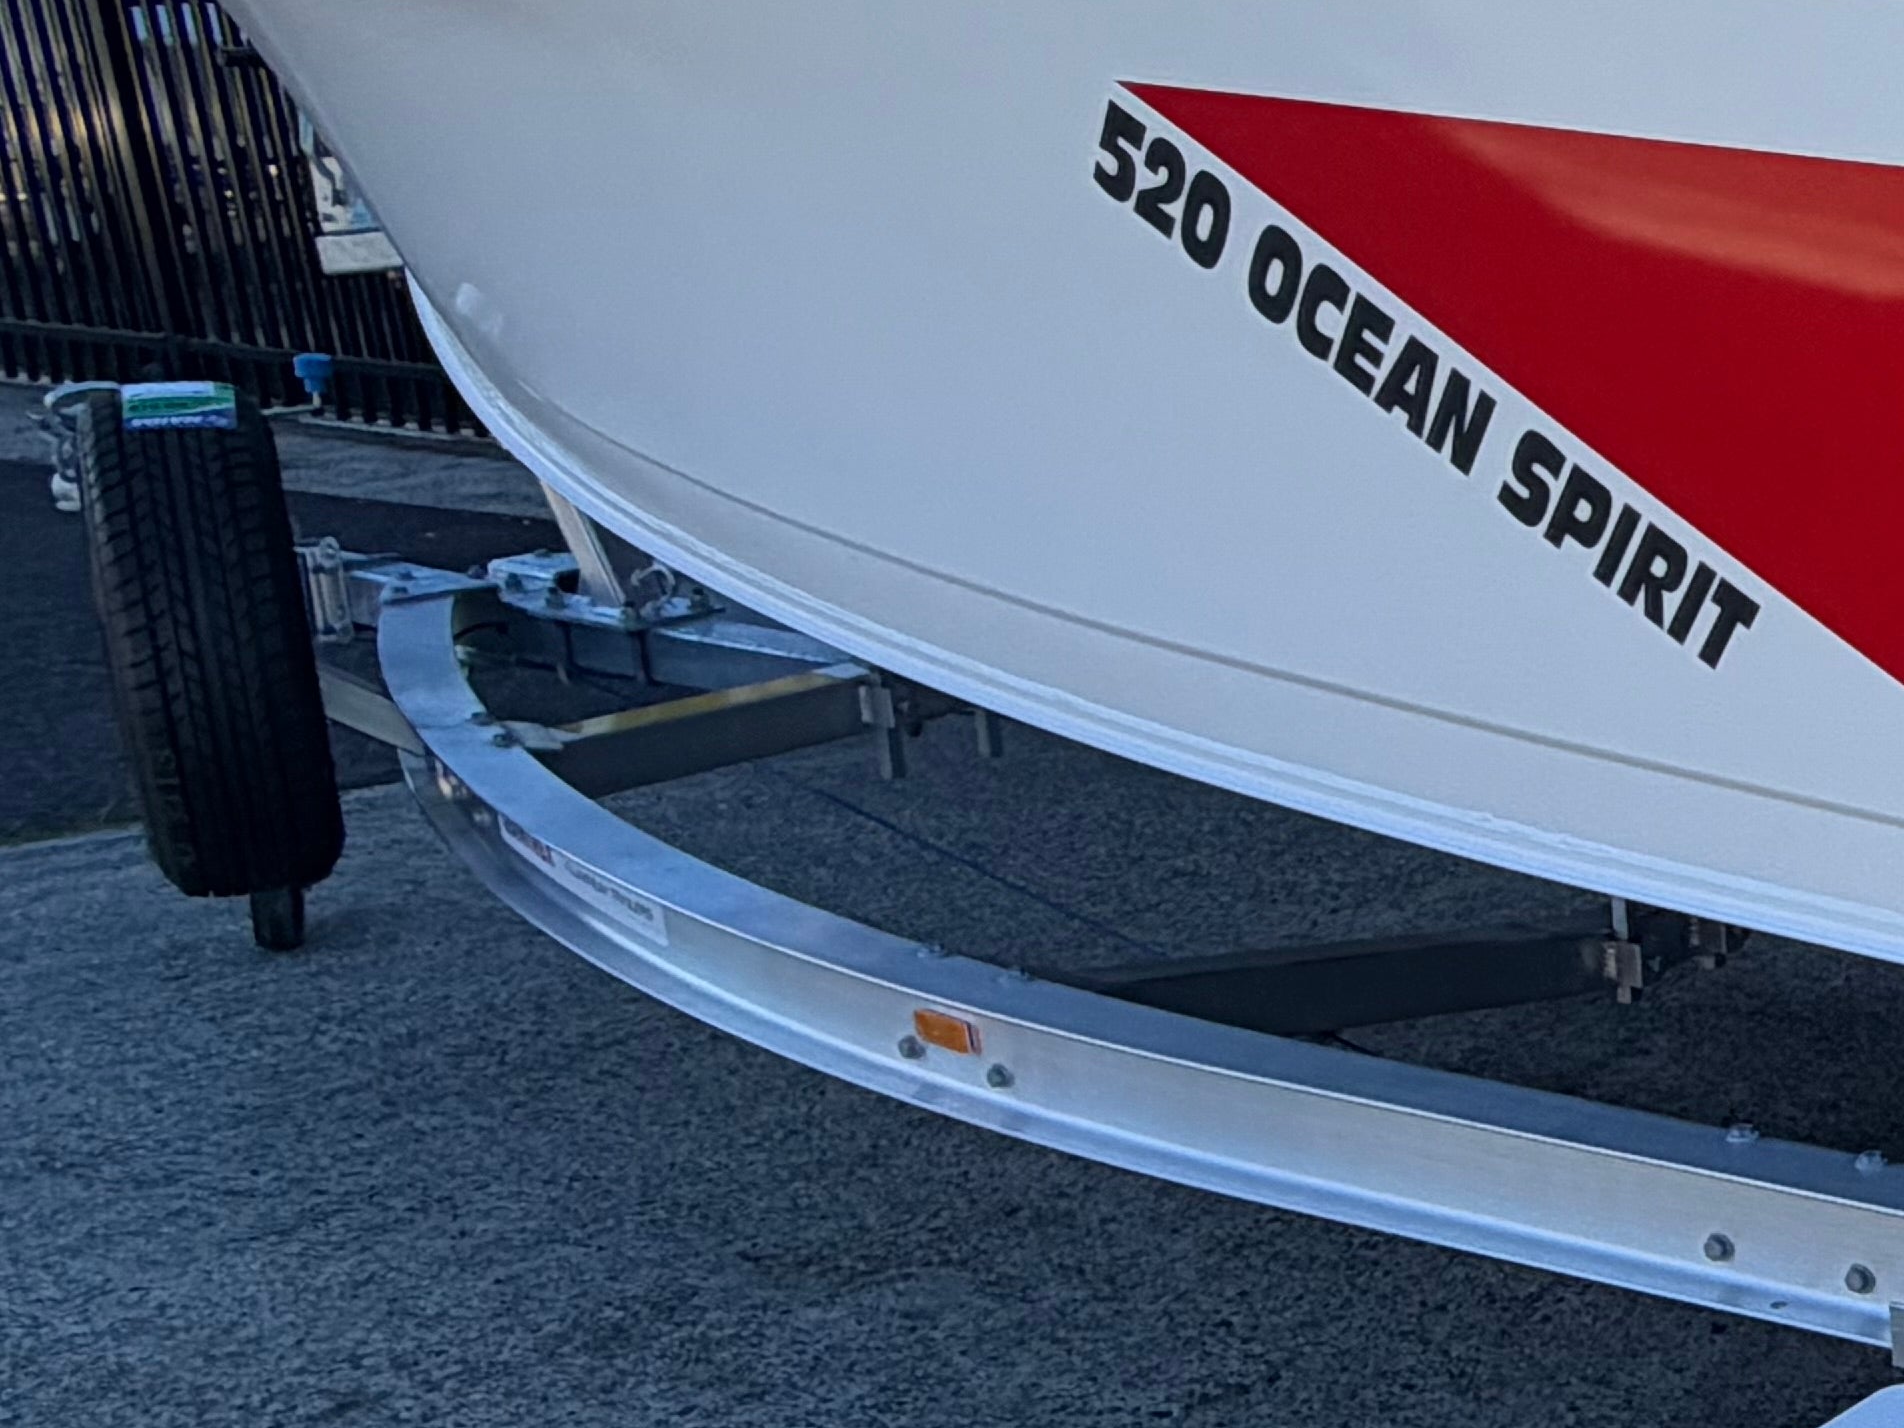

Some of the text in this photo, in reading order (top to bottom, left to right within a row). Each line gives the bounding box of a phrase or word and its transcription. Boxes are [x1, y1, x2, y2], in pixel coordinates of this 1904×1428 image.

[1093, 99, 1761, 670] 520 OCEAN SPIRIT
